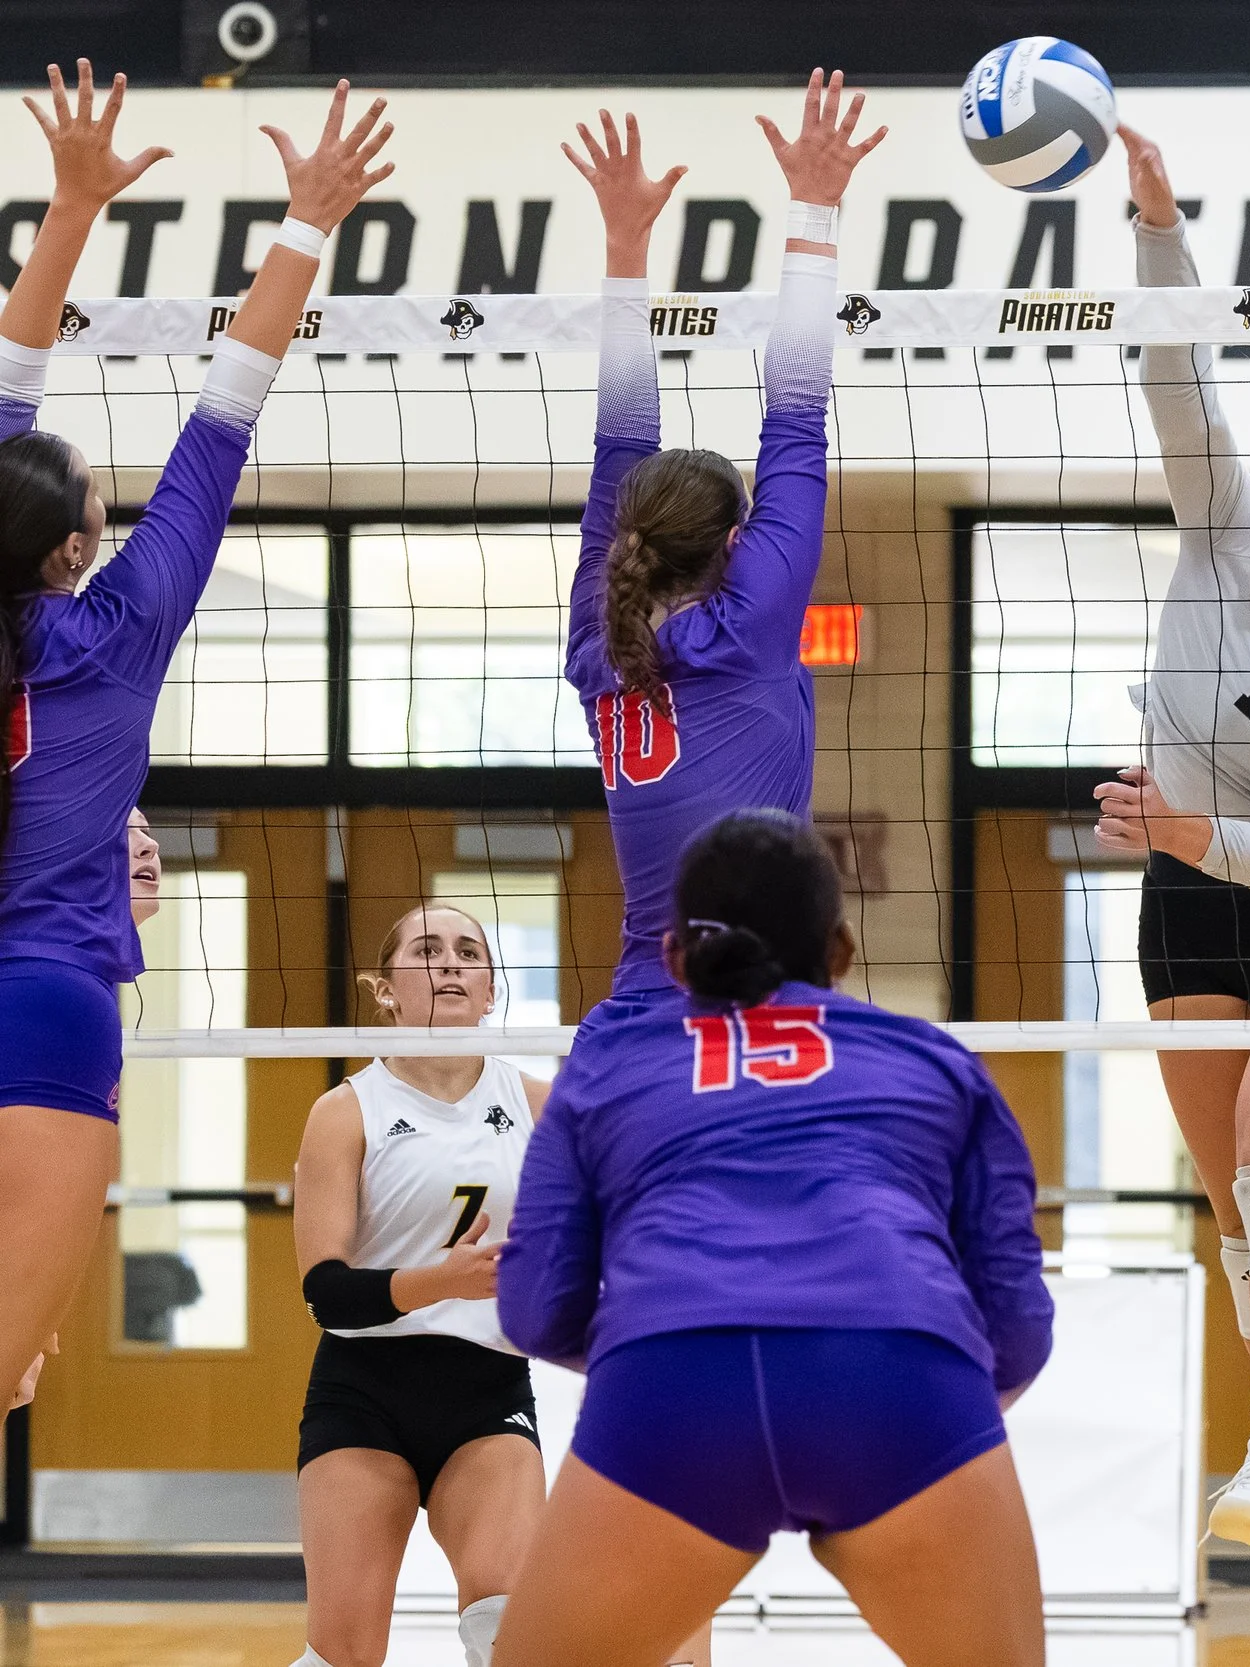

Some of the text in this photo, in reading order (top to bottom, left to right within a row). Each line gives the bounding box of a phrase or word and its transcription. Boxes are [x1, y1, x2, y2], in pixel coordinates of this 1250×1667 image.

[650, 307, 719, 337] ATES
[998, 299, 1116, 334] PIRATES
[683, 1004, 834, 1094] 15
[387, 1127, 417, 1137] adidas
[440, 1184, 490, 1249] 7
